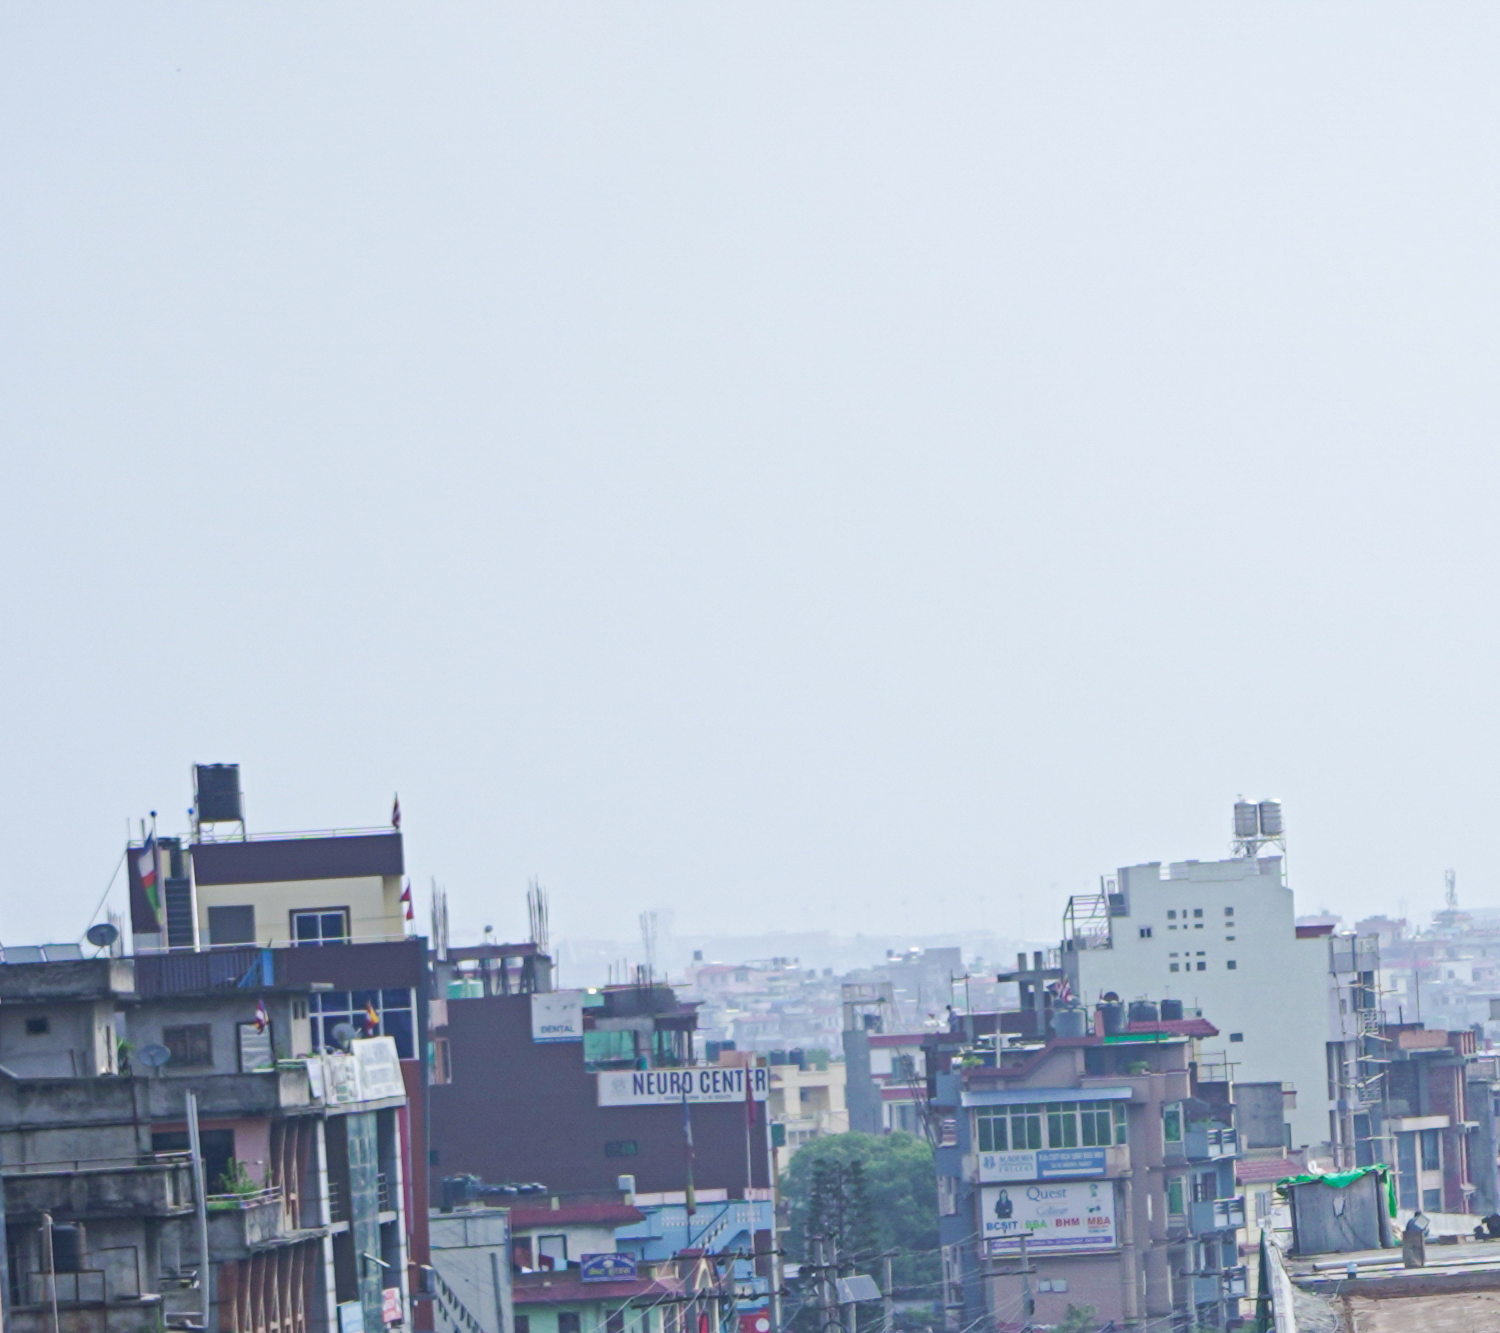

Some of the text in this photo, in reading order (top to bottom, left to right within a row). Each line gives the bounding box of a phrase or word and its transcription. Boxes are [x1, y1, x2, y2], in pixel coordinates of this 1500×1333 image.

[541, 1025, 575, 1034] DENTAL
[632, 1069, 766, 1095] NEURO CENTER
[1026, 1186, 1067, 1202] Quest
[986, 1221, 1018, 1231] BCSIT
[1055, 1218, 1080, 1228] BHM
[1087, 1216, 1111, 1226] MBA
